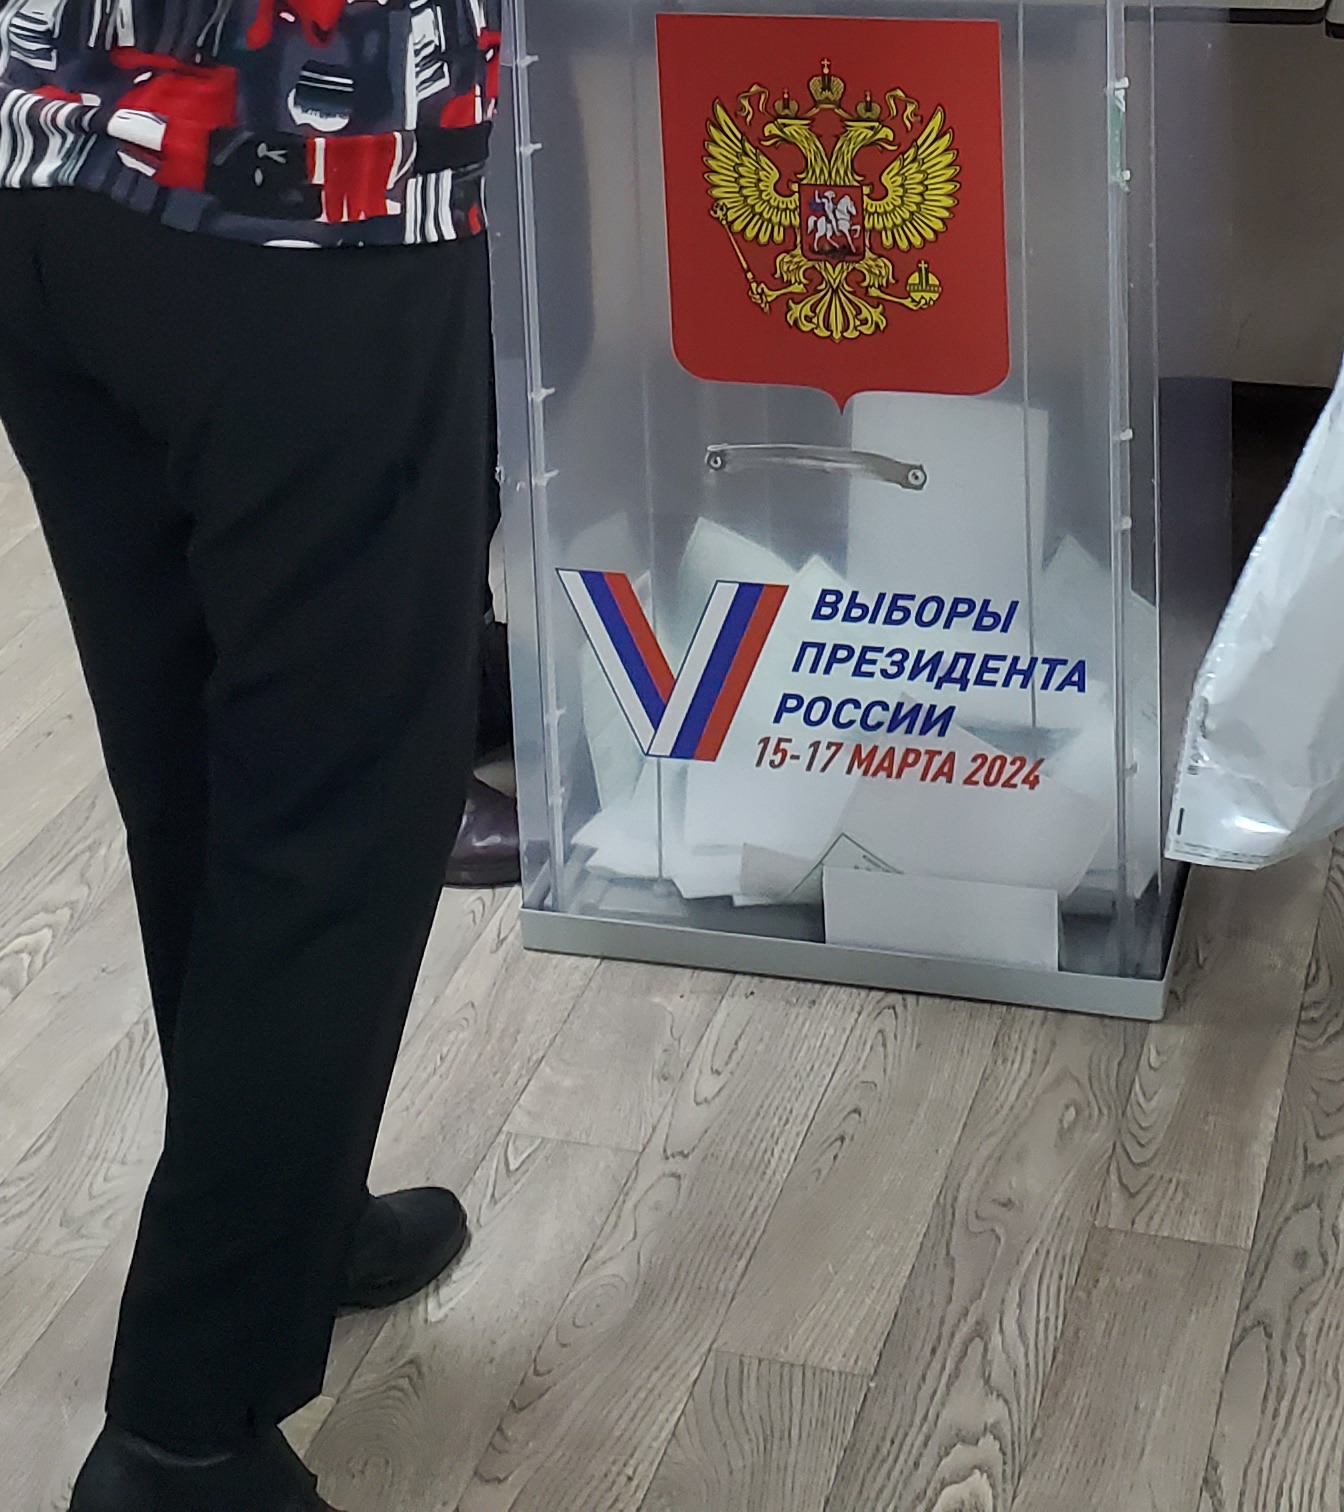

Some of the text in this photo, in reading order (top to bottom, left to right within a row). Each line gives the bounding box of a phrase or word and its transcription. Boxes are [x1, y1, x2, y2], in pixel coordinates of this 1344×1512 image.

[810, 589, 1020, 632] ВЫБОРЫ
[790, 641, 1086, 692] ПРЕЗИДЕНТА
[771, 693, 957, 736] РОССИИ
[848, 742, 957, 784] МАРТА
[961, 752, 1046, 791] 2024
